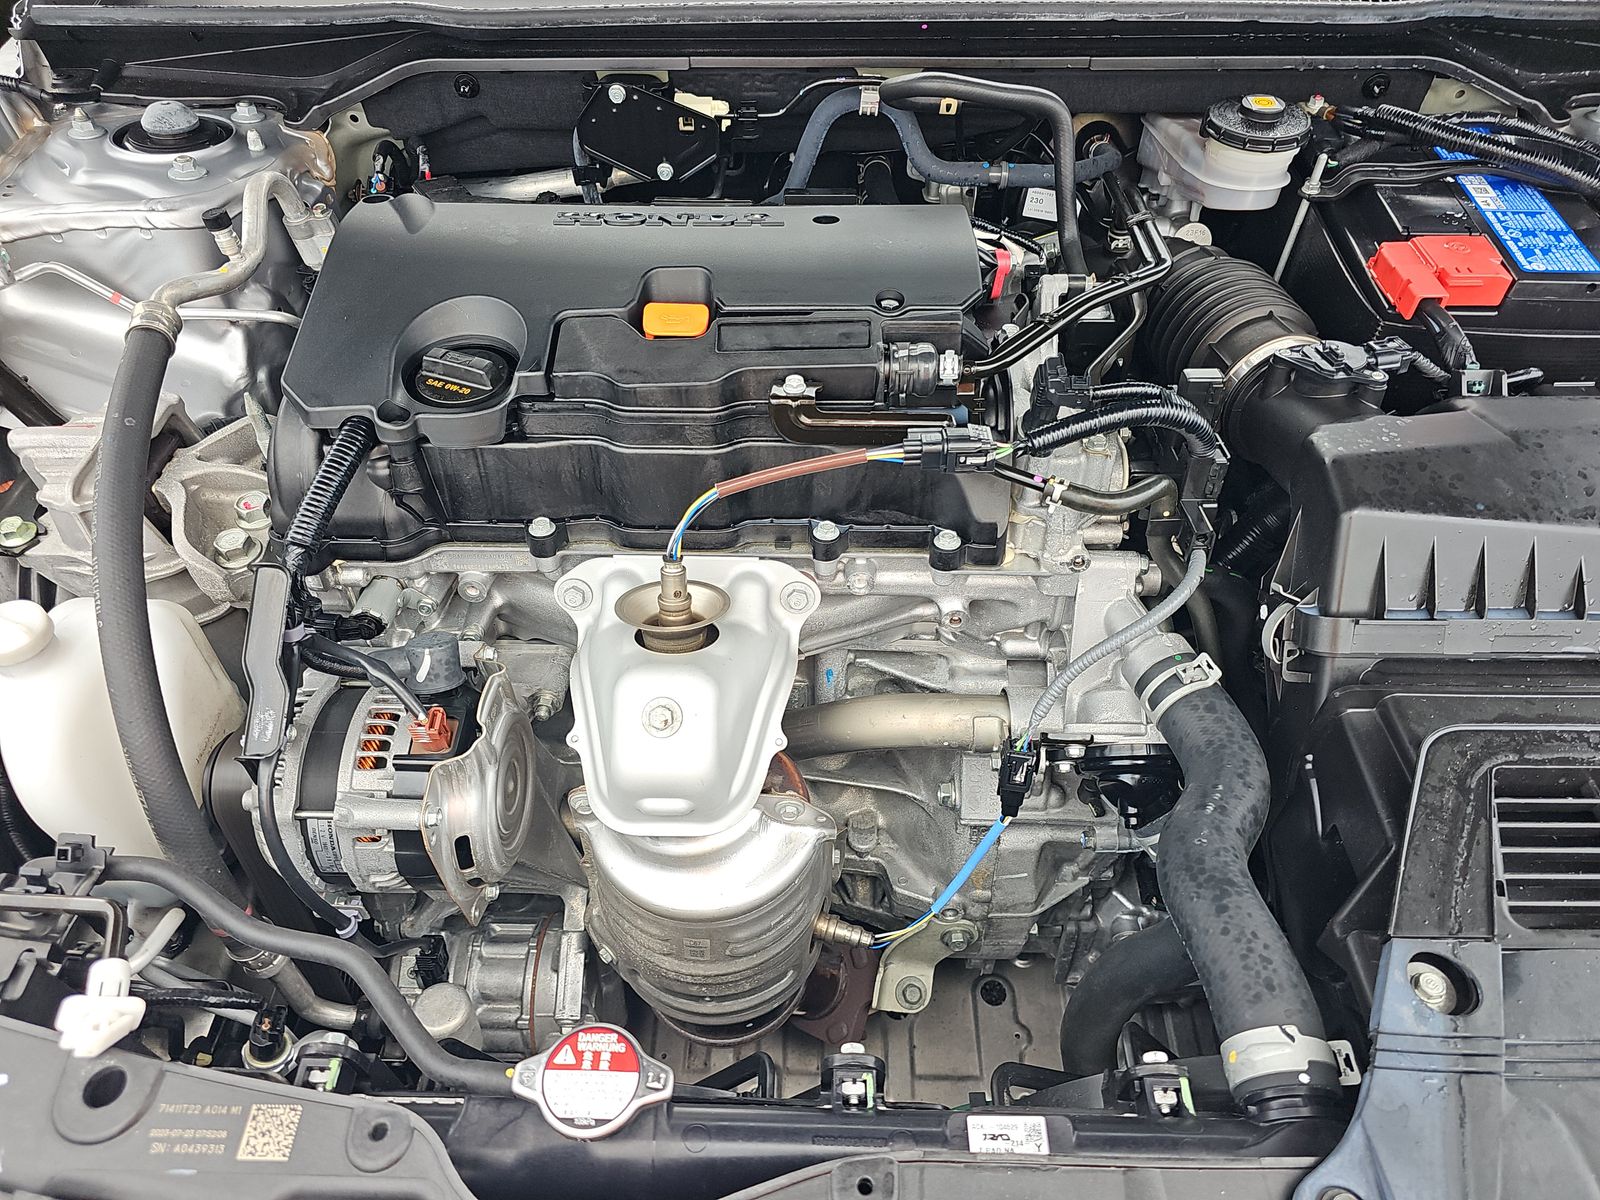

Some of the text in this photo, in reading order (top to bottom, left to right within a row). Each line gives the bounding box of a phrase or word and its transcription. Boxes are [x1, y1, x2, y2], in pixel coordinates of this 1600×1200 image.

[1029, 196, 1044, 205] 230
[552, 211, 785, 227] HONDA
[425, 378, 472, 395] SAE 0W-20
[327, 820, 336, 851] HONDA
[577, 1032, 619, 1043] DANGER
